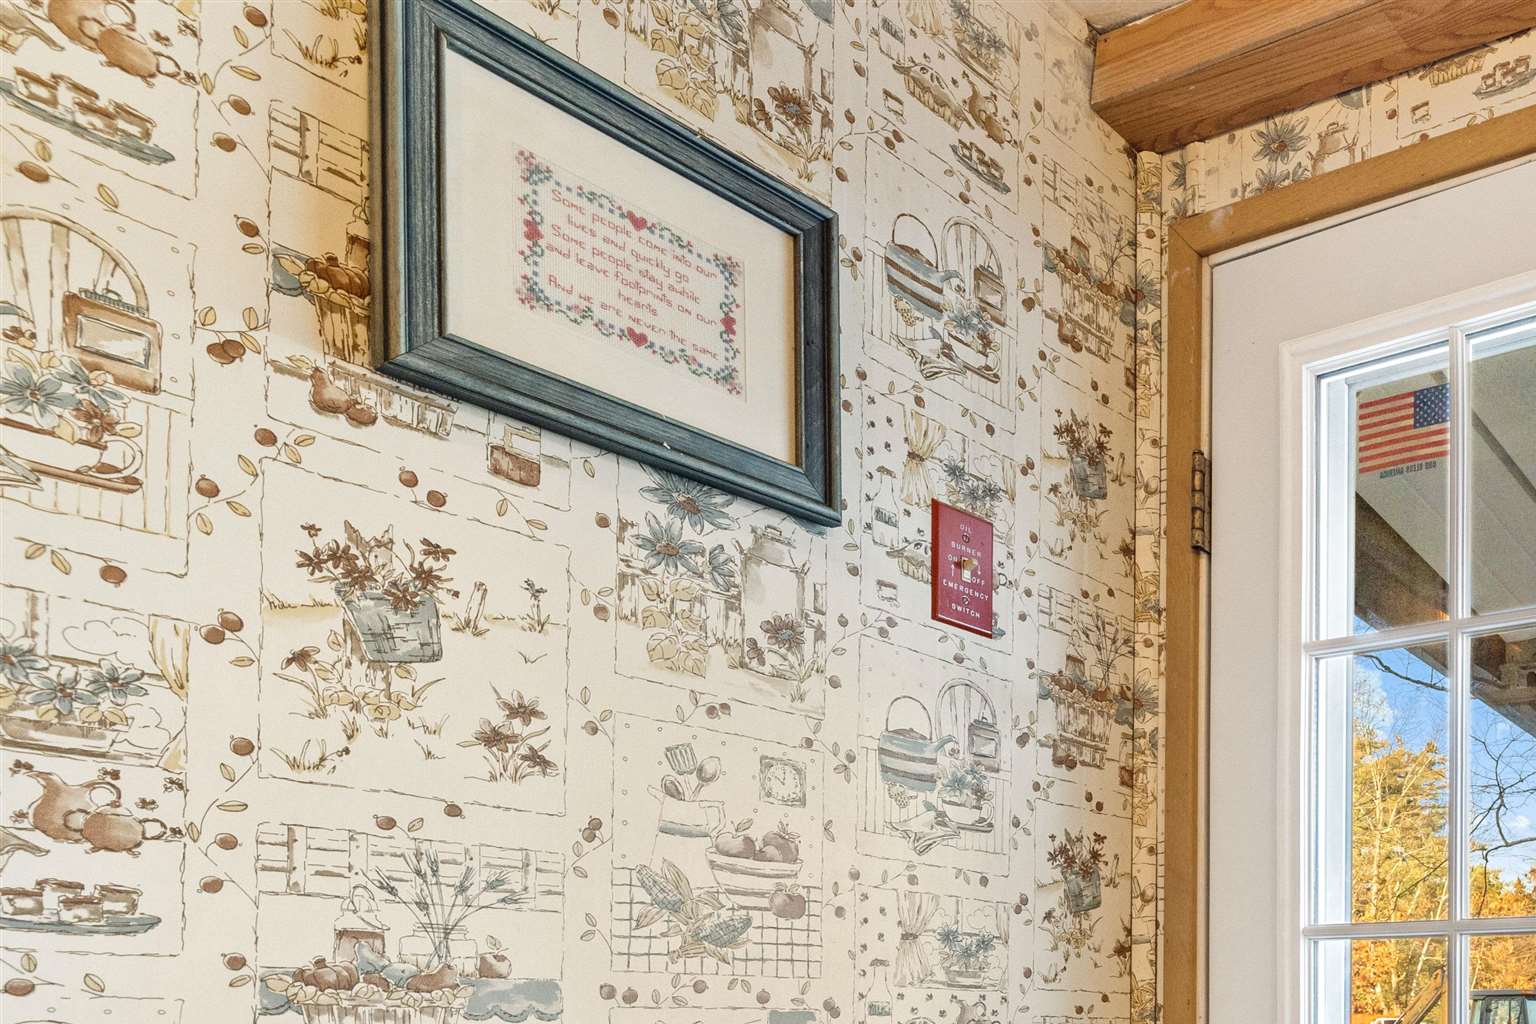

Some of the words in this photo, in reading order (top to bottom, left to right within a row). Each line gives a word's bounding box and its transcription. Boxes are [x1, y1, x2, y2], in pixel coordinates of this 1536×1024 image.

[552, 189, 585, 215] Some
[592, 213, 632, 238] people
[639, 236, 668, 256] come
[696, 265, 718, 278] our
[552, 224, 585, 250] Some
[592, 247, 632, 272] people
[639, 269, 663, 291] stay
[567, 214, 597, 237] lives
[602, 235, 626, 251] and
[631, 249, 671, 278] quickly
[674, 271, 689, 283] go
[545, 242, 571, 259] and
[576, 253, 609, 277] leave
[614, 270, 673, 308] footprints
[696, 313, 717, 326] our
[548, 274, 573, 295] And
[618, 289, 658, 316] hearts
[960, 523, 973, 533] OIL
[947, 554, 958, 562] ON
[951, 541, 982, 558] BURNER
[943, 578, 990, 601] EMERGENCY
[971, 576, 986, 586] OFF
[951, 602, 981, 618] SWITCH
